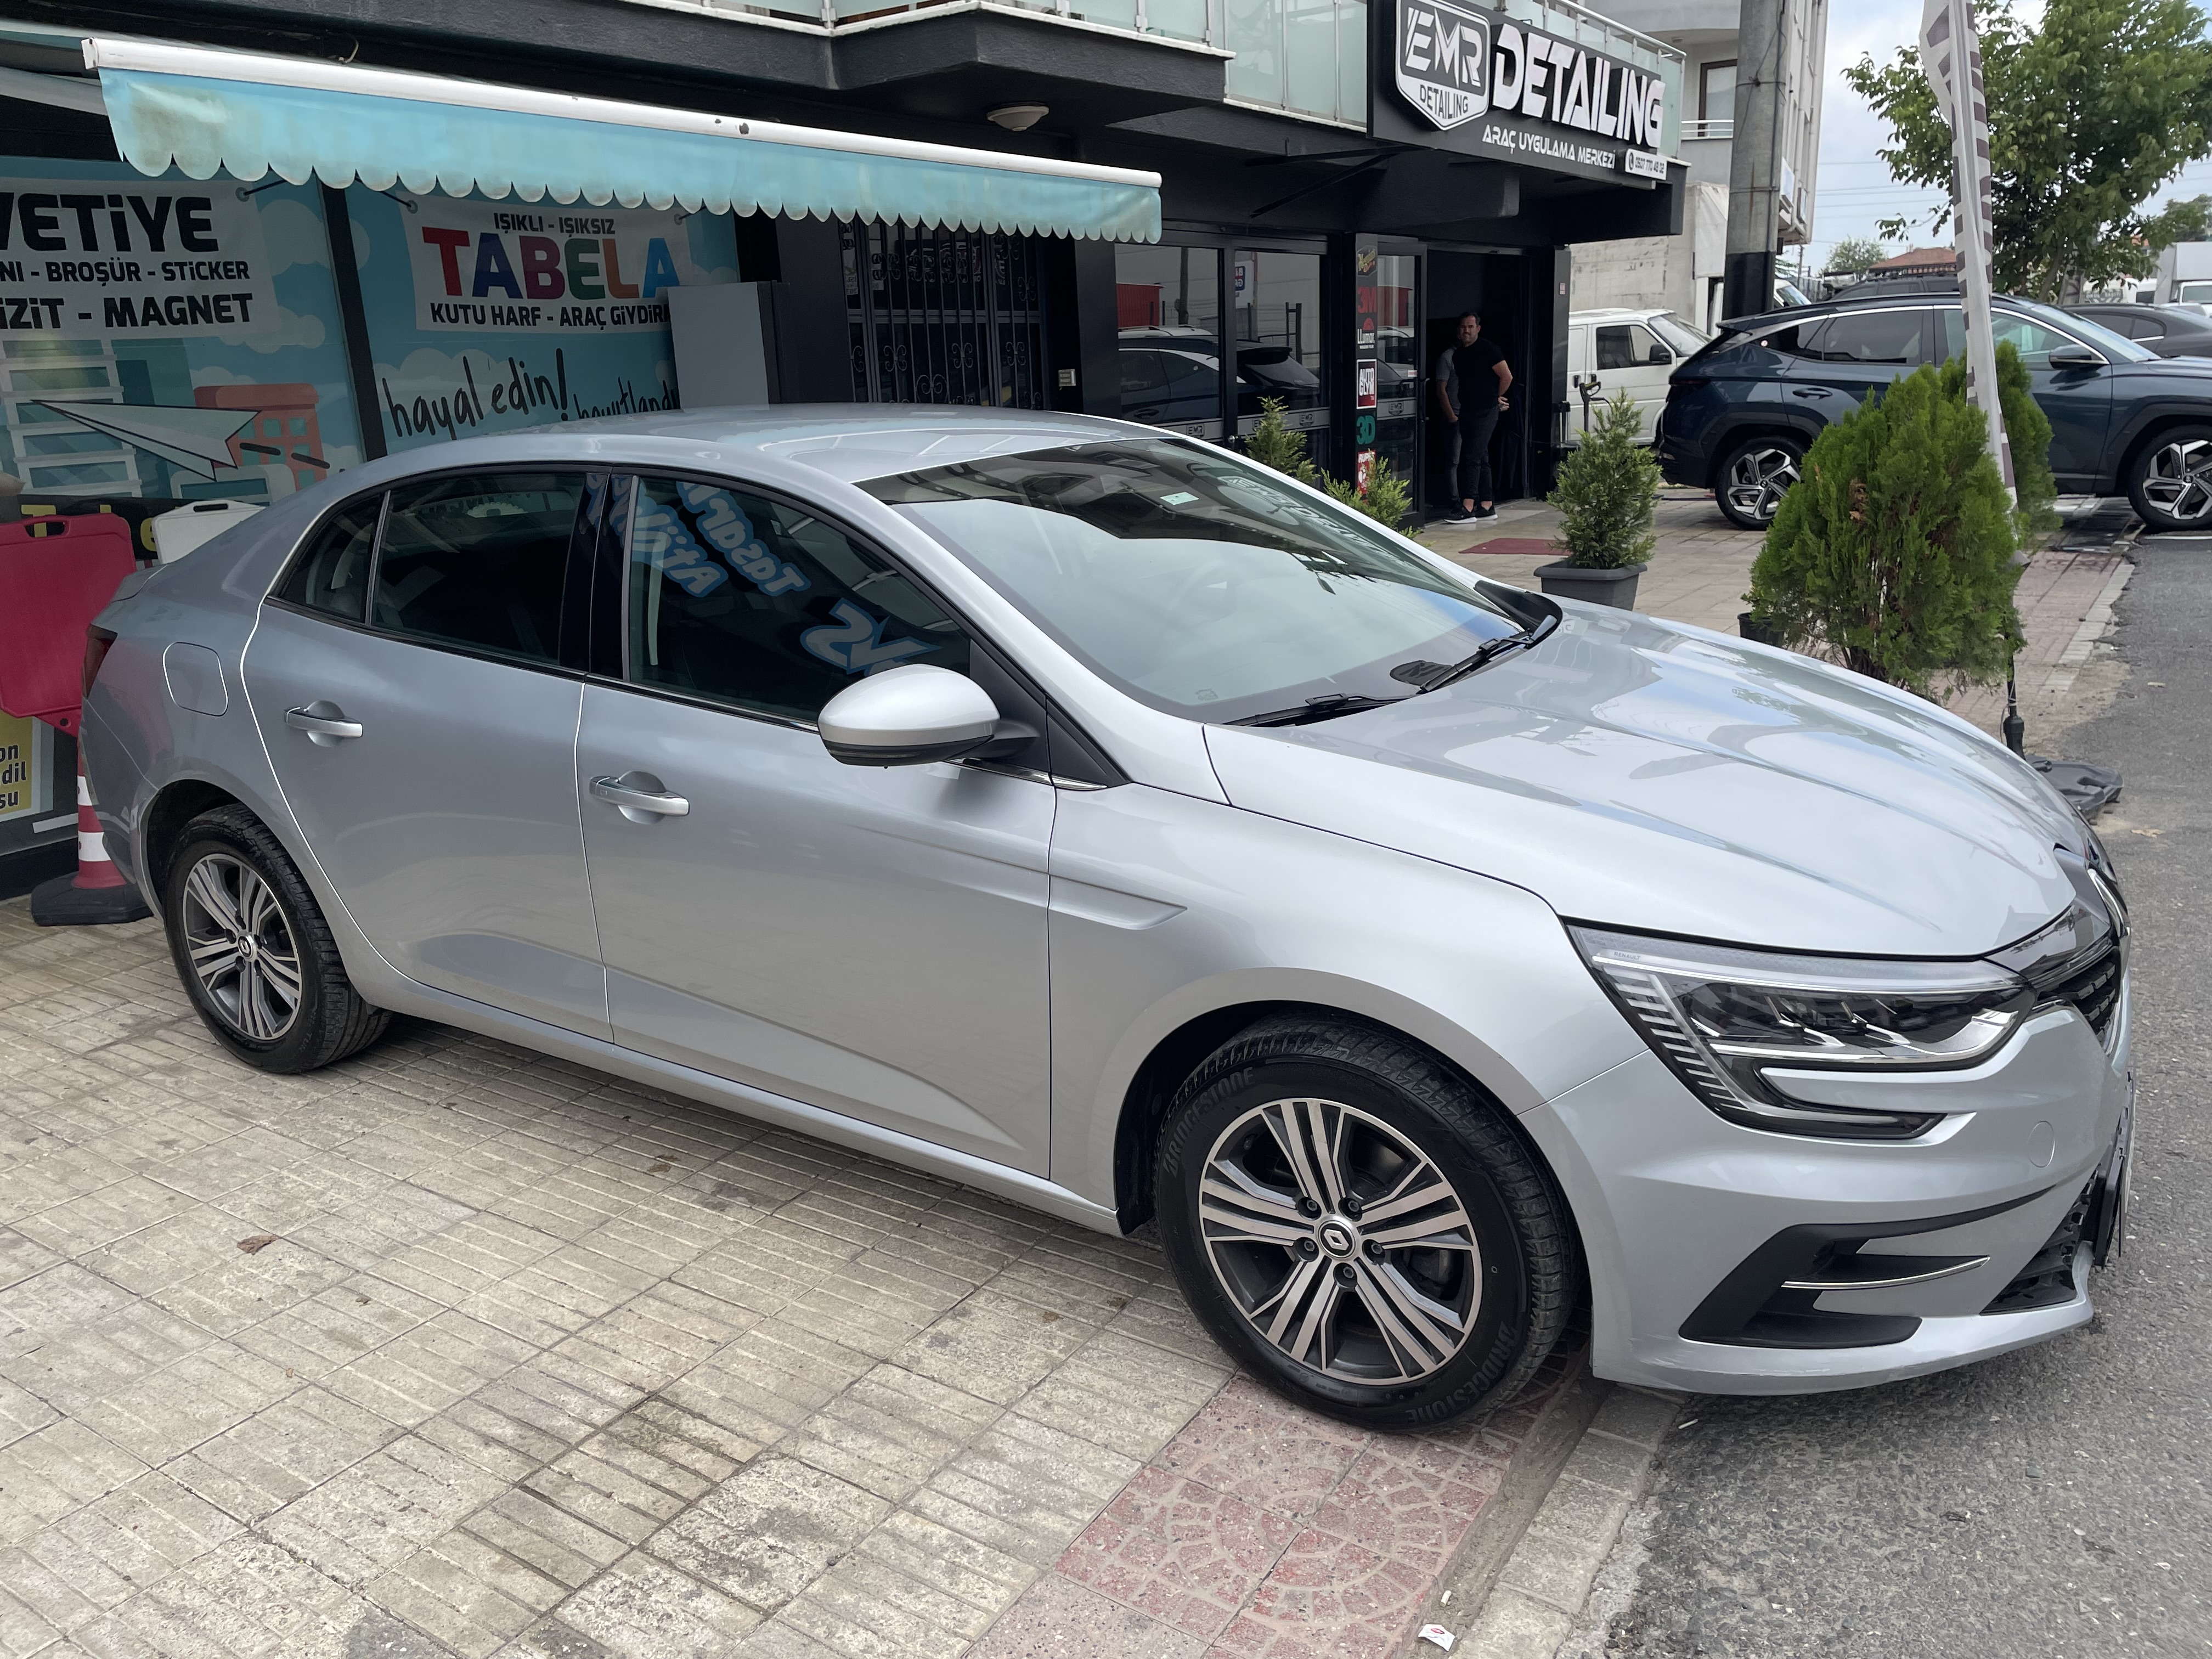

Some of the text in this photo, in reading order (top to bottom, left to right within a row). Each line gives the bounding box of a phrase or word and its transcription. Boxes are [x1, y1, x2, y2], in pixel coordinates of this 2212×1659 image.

[1405, 7, 1483, 89] EMR
[1420, 84, 1469, 120] DETAILING
[1492, 22, 1667, 149] DETAILING
[1482, 124, 1616, 169] ARAÇ UYGULAMA MERKEZİ
[494, 212, 544, 234] IŞIKLI
[558, 217, 616, 238] IŞIKSIZ
[46, 257, 142, 286] BROŞÜR
[422, 226, 681, 300] TABELA
[104, 293, 253, 328] MAGNET
[430, 302, 486, 325] KUTU
[491, 306, 541, 326] HARF
[560, 306, 607, 330] ARAÇ
[1357, 286, 1377, 314] 3M
[1359, 367, 1375, 382] AUTO
[382, 348, 568, 441] hayal edin!
[1188, 425, 1203, 435] EMR
[1356, 415, 1376, 445] 3D
[1614, 951, 1641, 960] RENAULT
[1162, 1066, 1256, 1178] BRIDGESTONE
[1405, 1320, 1520, 1424] BRIDGESTONE
